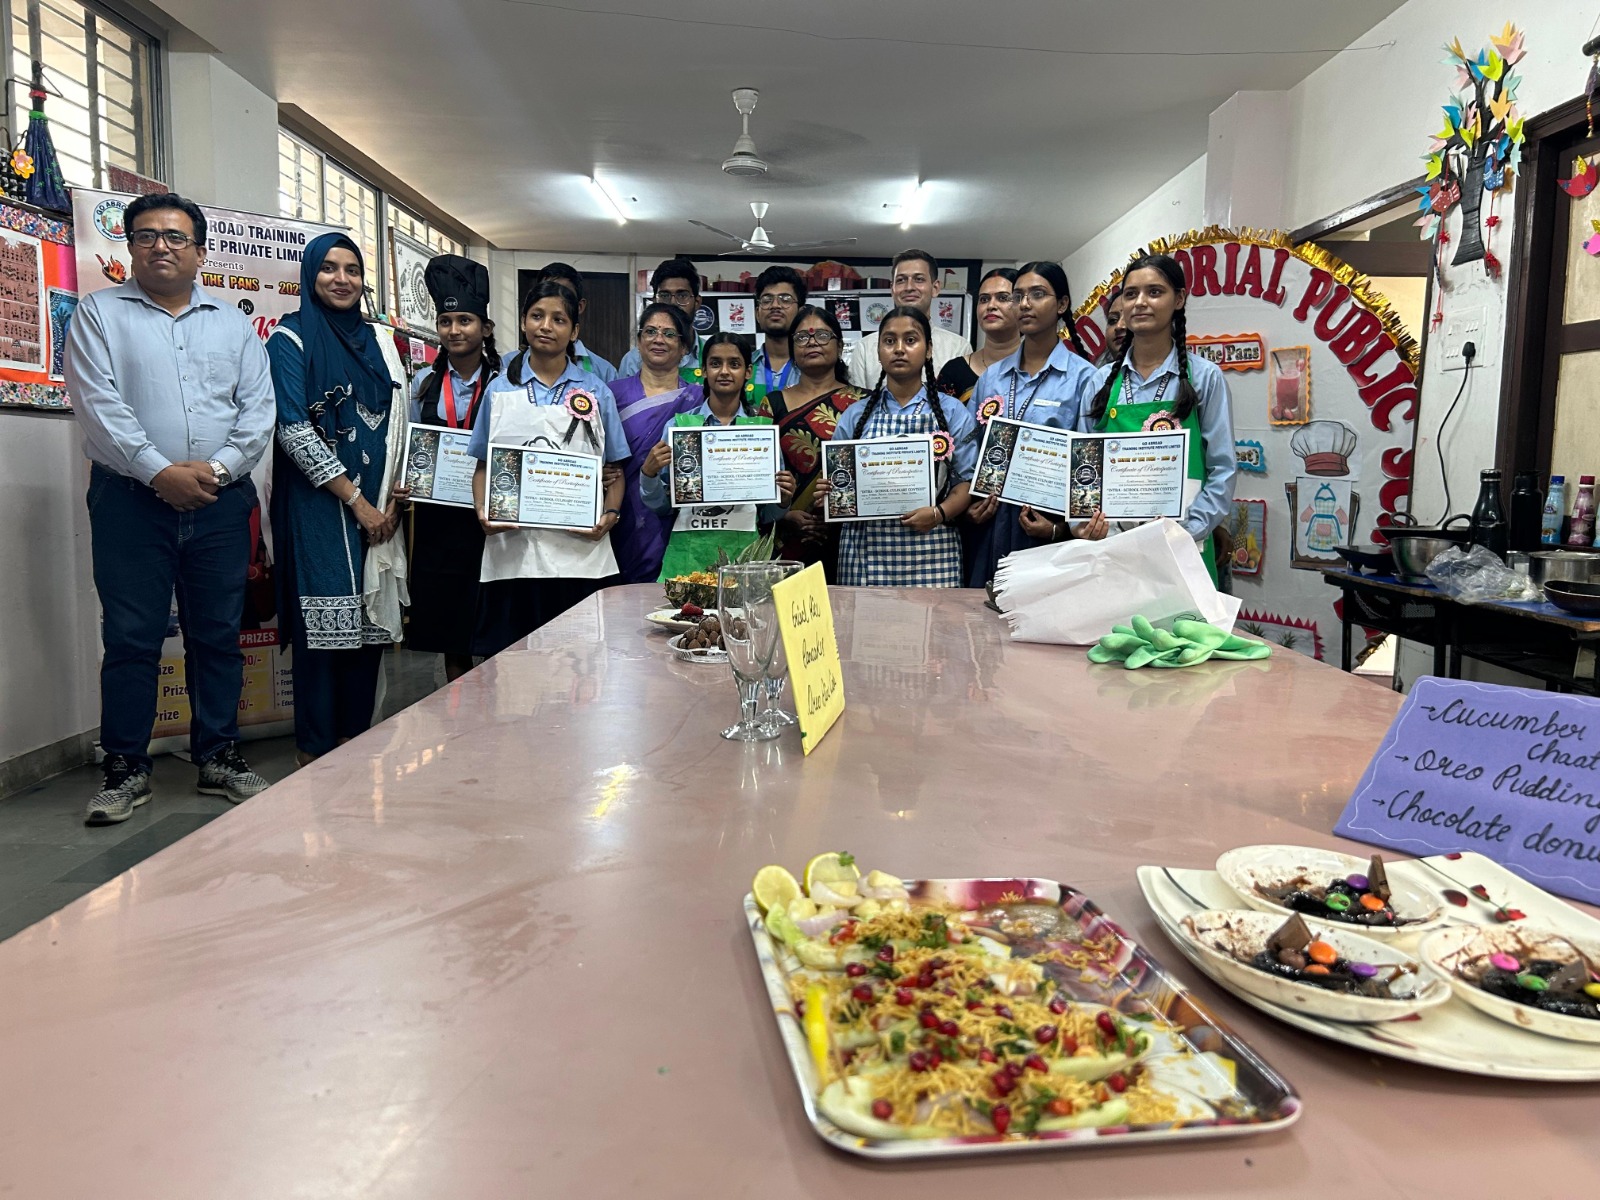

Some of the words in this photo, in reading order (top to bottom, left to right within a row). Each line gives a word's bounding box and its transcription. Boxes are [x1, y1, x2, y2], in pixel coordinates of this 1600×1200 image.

[206, 220, 244, 236] ROAD
[248, 225, 306, 246] TRAINING
[220, 240, 272, 258] PRIVATE
[276, 247, 304, 262] LIMI
[202, 258, 244, 270] Presents
[200, 272, 225, 288] THE
[229, 276, 260, 292] PANS
[279, 281, 300, 296] 202
[240, 301, 253, 313] by
[1174, 243, 1289, 306] ORIAL
[1292, 267, 1416, 432] PUBLIC
[1198, 346, 1222, 362] The
[1225, 344, 1259, 361] Pans
[690, 518, 728, 529] CHEF
[240, 632, 276, 645] PRIZES
[158, 664, 174, 675] ize
[1428, 698, 1586, 741] Cucumber
[1414, 750, 1484, 781] Oreo
[1492, 764, 1600, 834] Pudding
[1386, 790, 1512, 842] Chocolate
[1522, 822, 1600, 862] donu
